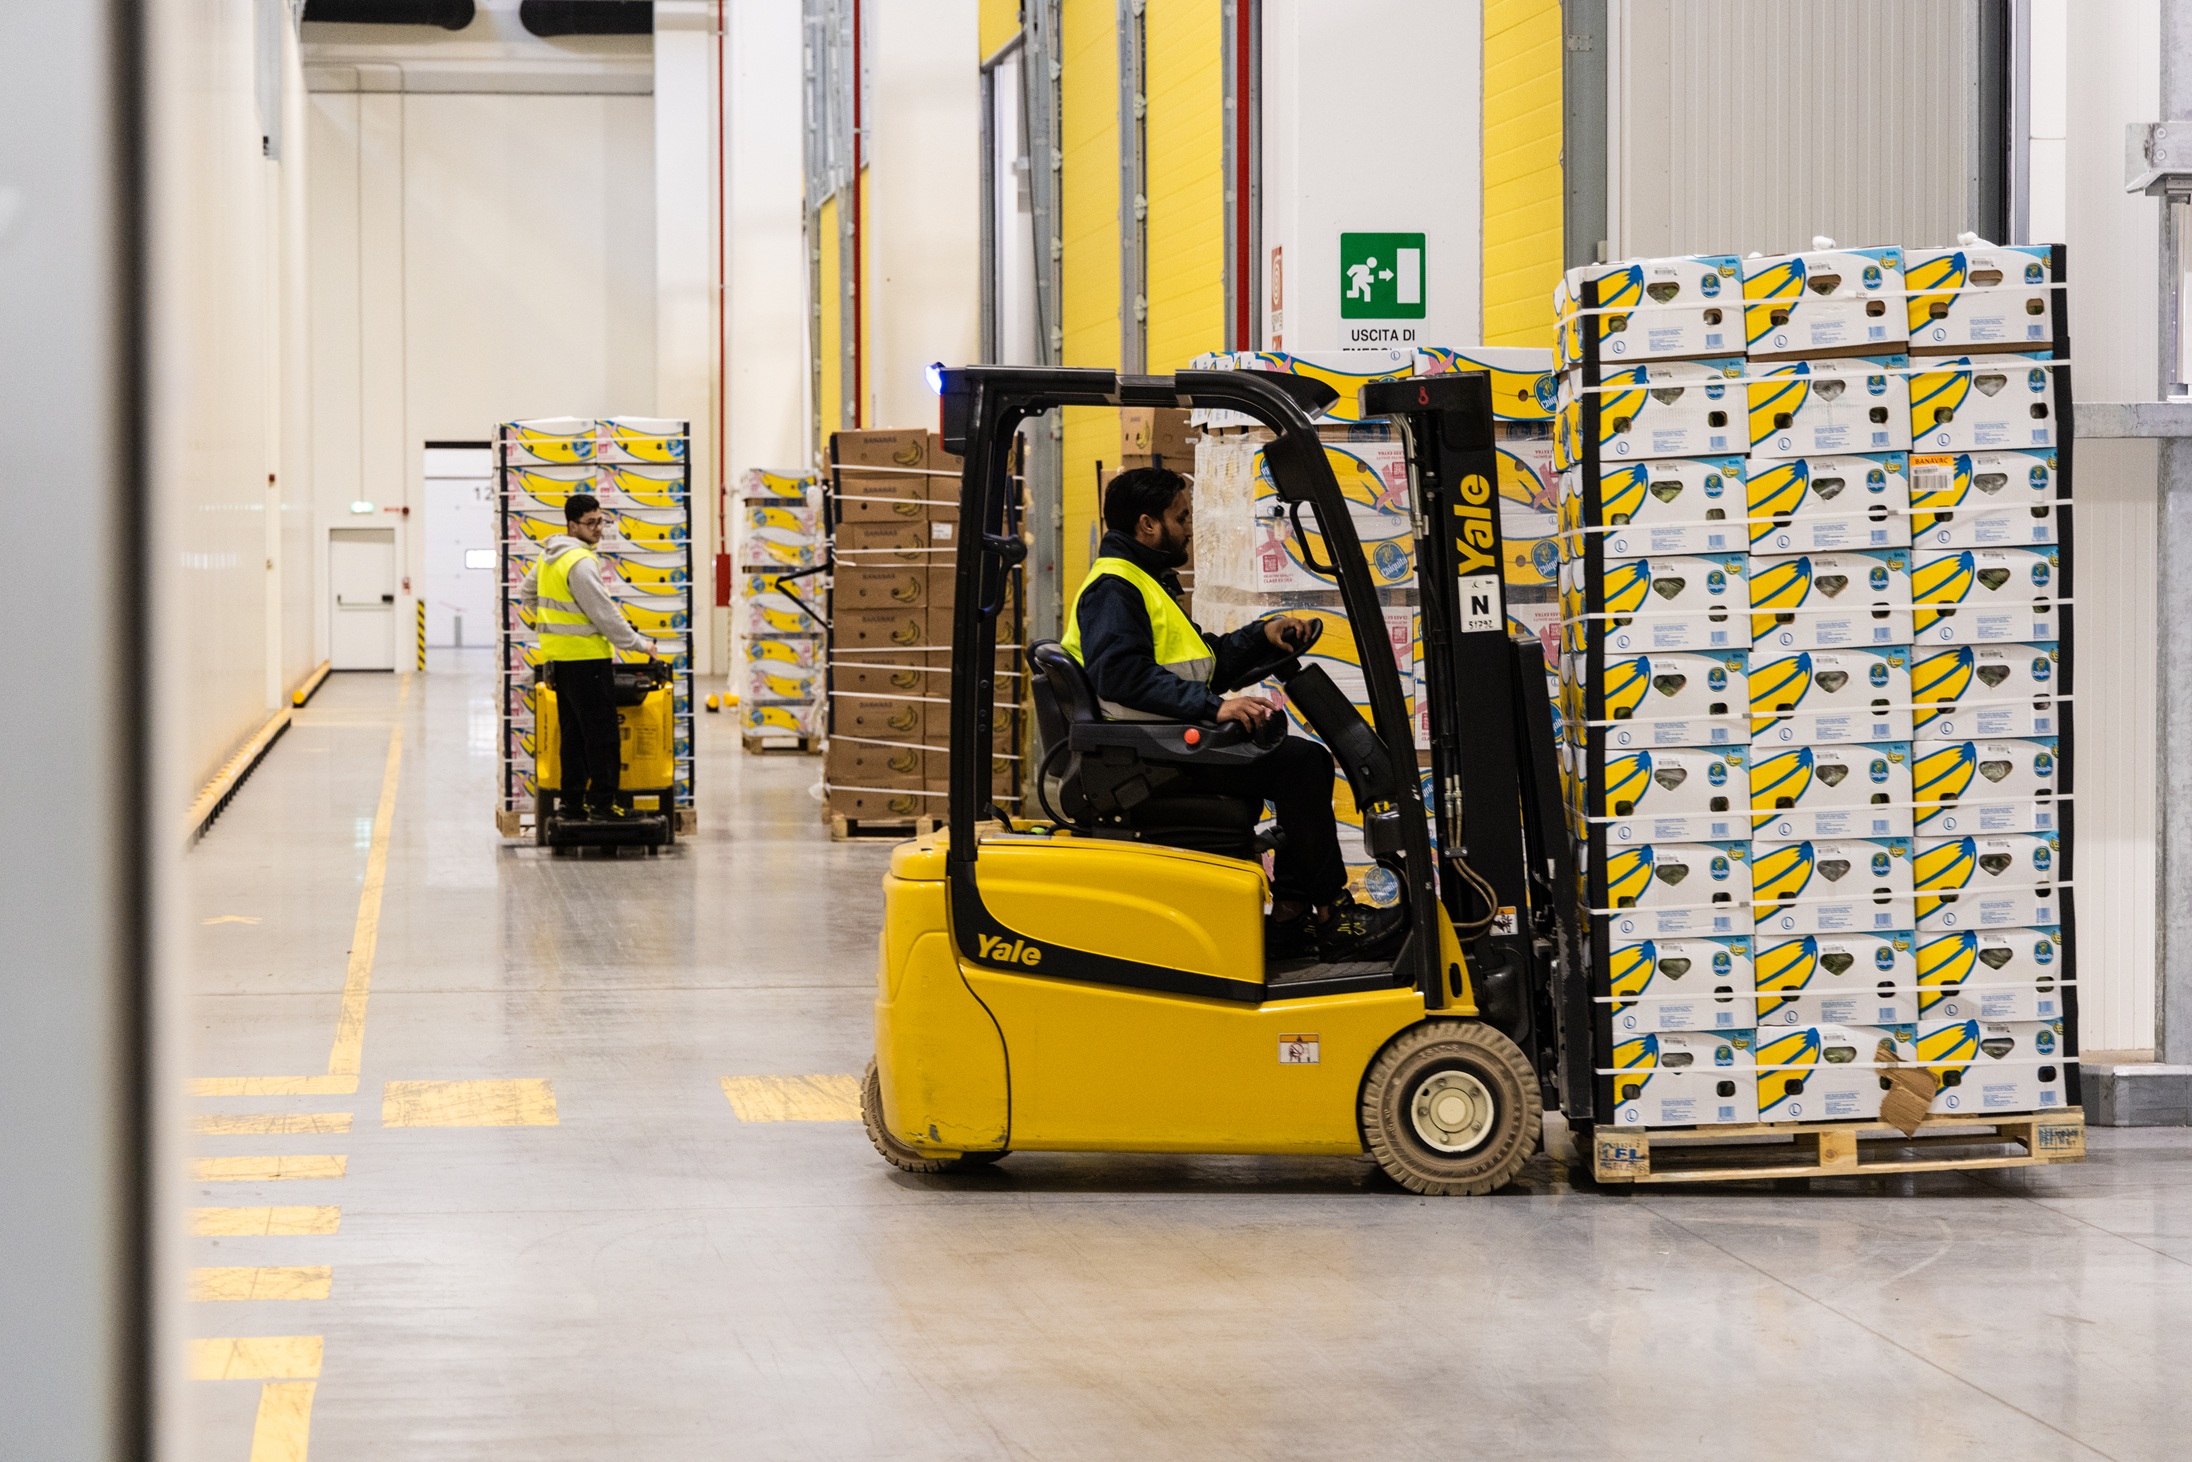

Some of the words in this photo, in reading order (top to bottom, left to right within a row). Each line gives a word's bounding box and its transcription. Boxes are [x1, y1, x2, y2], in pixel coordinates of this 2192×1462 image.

[1351, 328, 1399, 342] USCITA
[1402, 328, 1416, 342] DI
[1915, 456, 1949, 465] BANAVAC
[1453, 473, 1496, 576] Yale
[1380, 556, 1408, 577] Chiquita
[1470, 594, 1489, 616] N
[977, 933, 1042, 966] Yale
